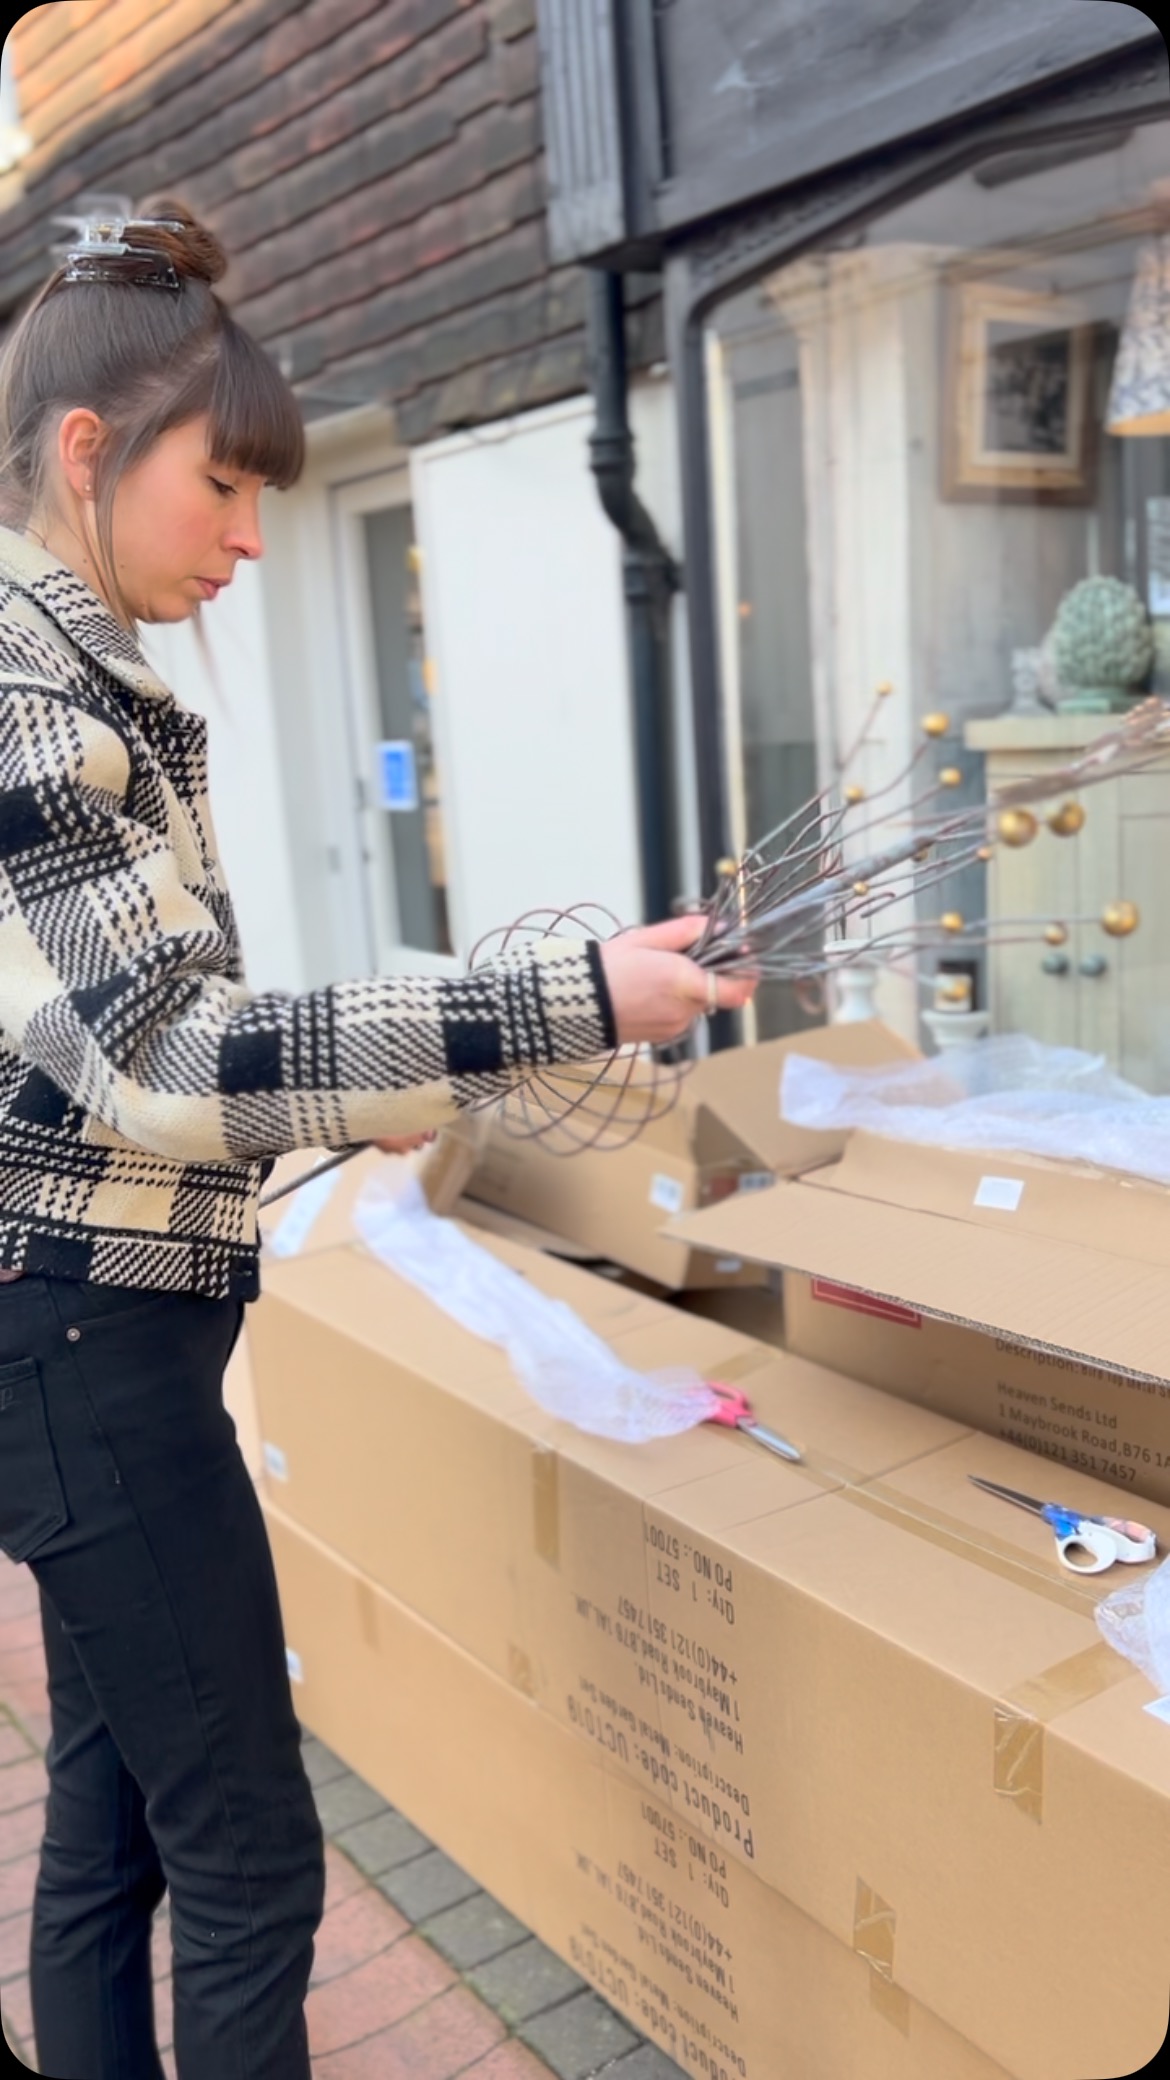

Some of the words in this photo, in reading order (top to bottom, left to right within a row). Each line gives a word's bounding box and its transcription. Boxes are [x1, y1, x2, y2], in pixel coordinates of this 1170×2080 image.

[998, 1381, 1047, 1406] Heaven
[1051, 1397, 1091, 1422] Sends
[1095, 1411, 1118, 1429] Ltd
[1009, 1406, 1078, 1442] Maybrook
[1071, 1453, 1096, 1470] 351
[1101, 1459, 1137, 1482] 7457
[656, 1560, 681, 1592] SET
[683, 1780, 754, 1859] Product
